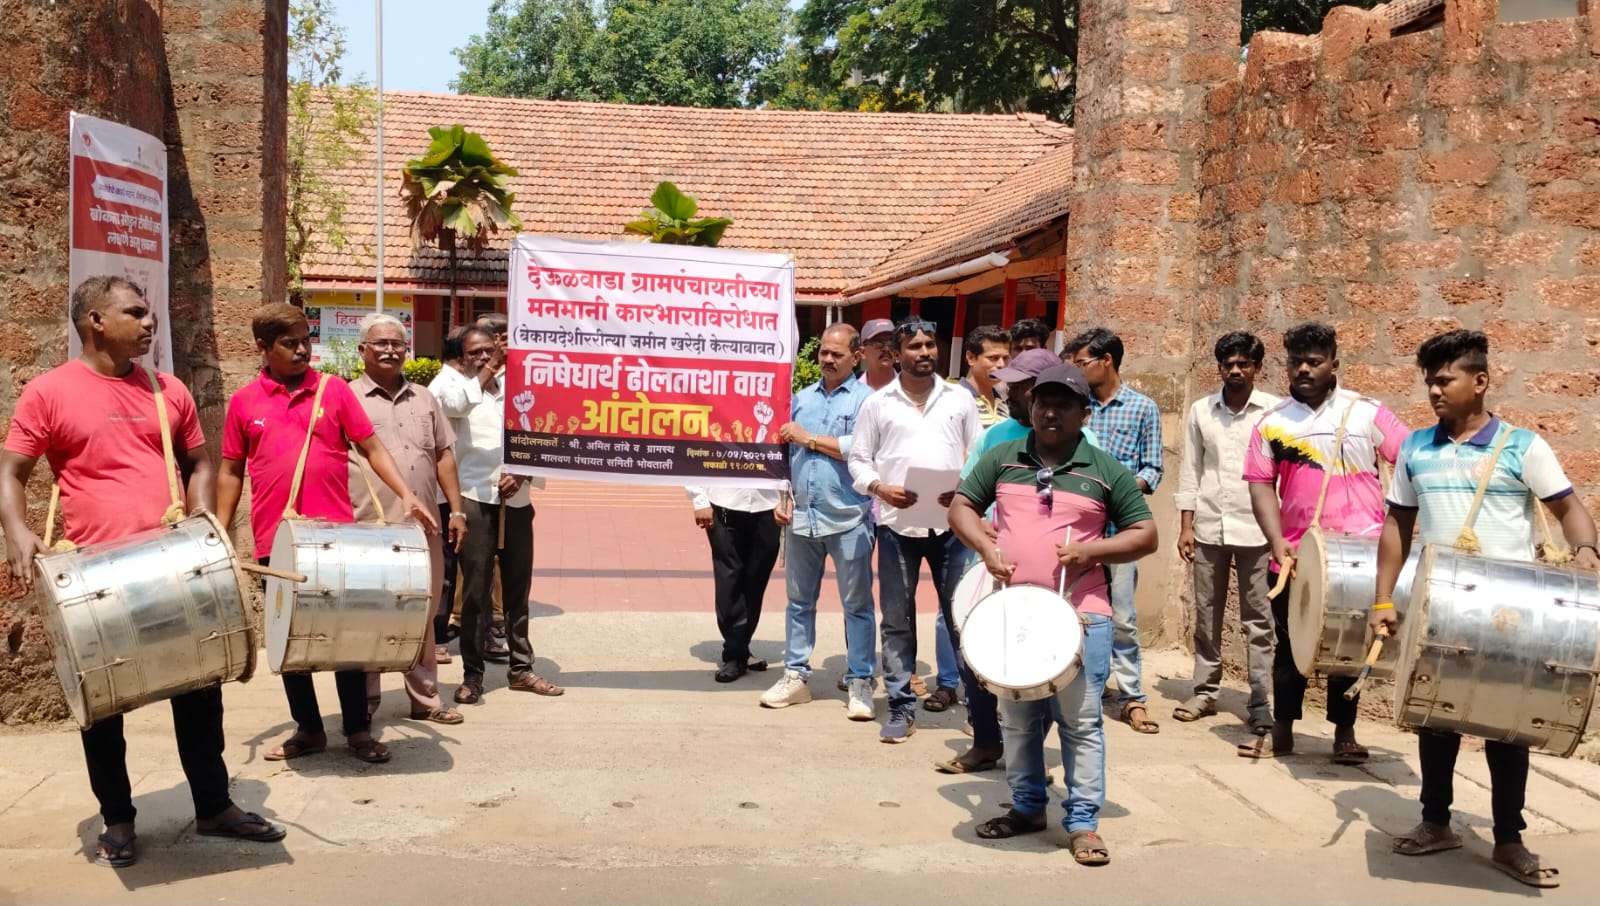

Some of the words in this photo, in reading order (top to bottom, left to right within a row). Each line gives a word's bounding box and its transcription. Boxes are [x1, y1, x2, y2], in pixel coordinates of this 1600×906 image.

[527, 258, 625, 291] देऊळवाडा
[631, 268, 780, 301] ग्रामपंचायतीच्या
[527, 296, 609, 321] मनमानी
[615, 301, 778, 332] कारभाराविरोधात
[630, 330, 667, 350] जमीन
[671, 332, 706, 355] खरेदी
[523, 352, 622, 390] निषेधार्थ
[626, 359, 728, 396] ढोलताशा
[733, 371, 775, 398] वाद्य
[581, 392, 713, 438] आंदोलन
[541, 453, 571, 464] मालवण
[574, 454, 603, 466] पंचायत
[607, 455, 634, 468] समिती
[586, 440, 611, 451] अमित
[633, 444, 641, 452] व
[647, 444, 675, 454] ग्रामस्थ
